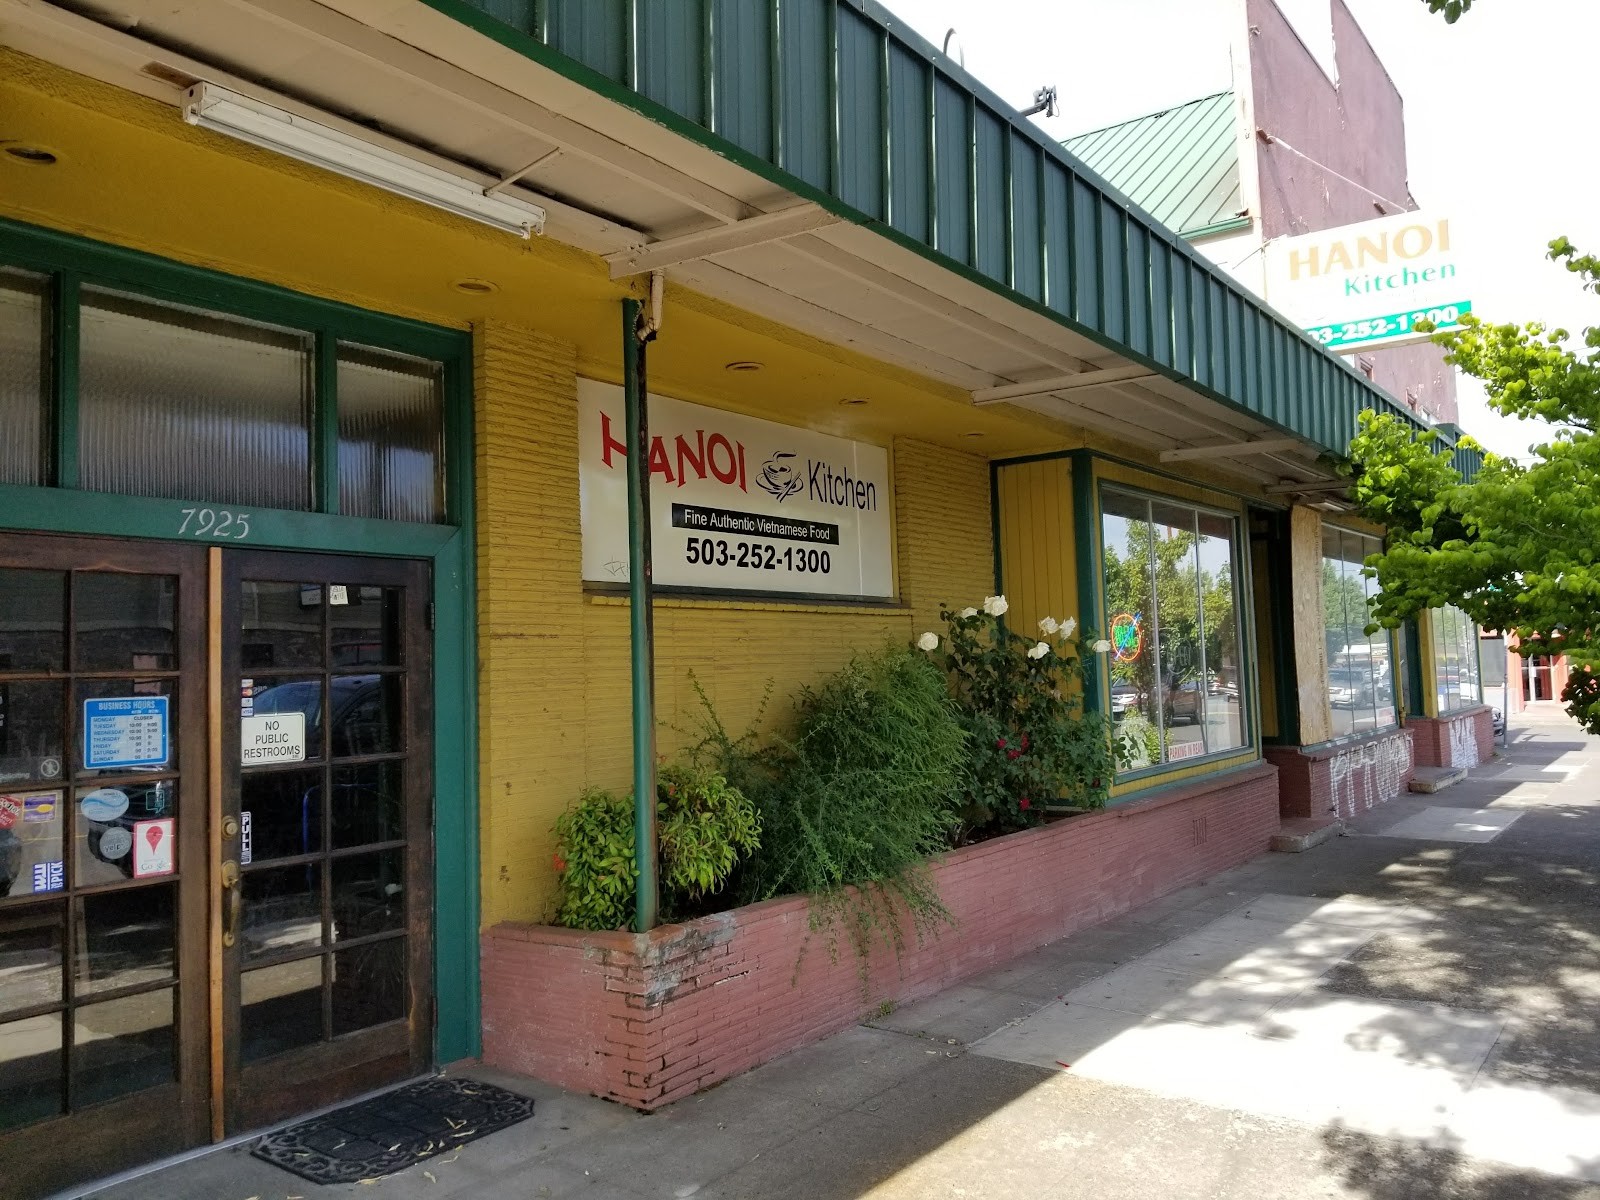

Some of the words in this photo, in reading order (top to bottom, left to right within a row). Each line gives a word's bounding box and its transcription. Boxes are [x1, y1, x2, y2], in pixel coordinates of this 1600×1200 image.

[1288, 219, 1451, 281] HANOI
[1344, 263, 1456, 296] Kitchen
[807, 459, 877, 511] Kitchen
[178, 508, 250, 538] 7925
[684, 508, 707, 526] Fine
[710, 512, 755, 531] Authentic
[756, 518, 808, 538] Vietnamese
[809, 525, 830, 540] Food
[686, 537, 831, 574] 503-252-1300
[98, 701, 132, 710] BUSINESS
[132, 700, 156, 709] HOURS
[255, 732, 289, 744] PUBLIC
[265, 720, 280, 731] NO
[244, 745, 300, 758] RESTROOMS
[242, 816, 250, 851] PULL
[141, 860, 166, 870] Gogle
